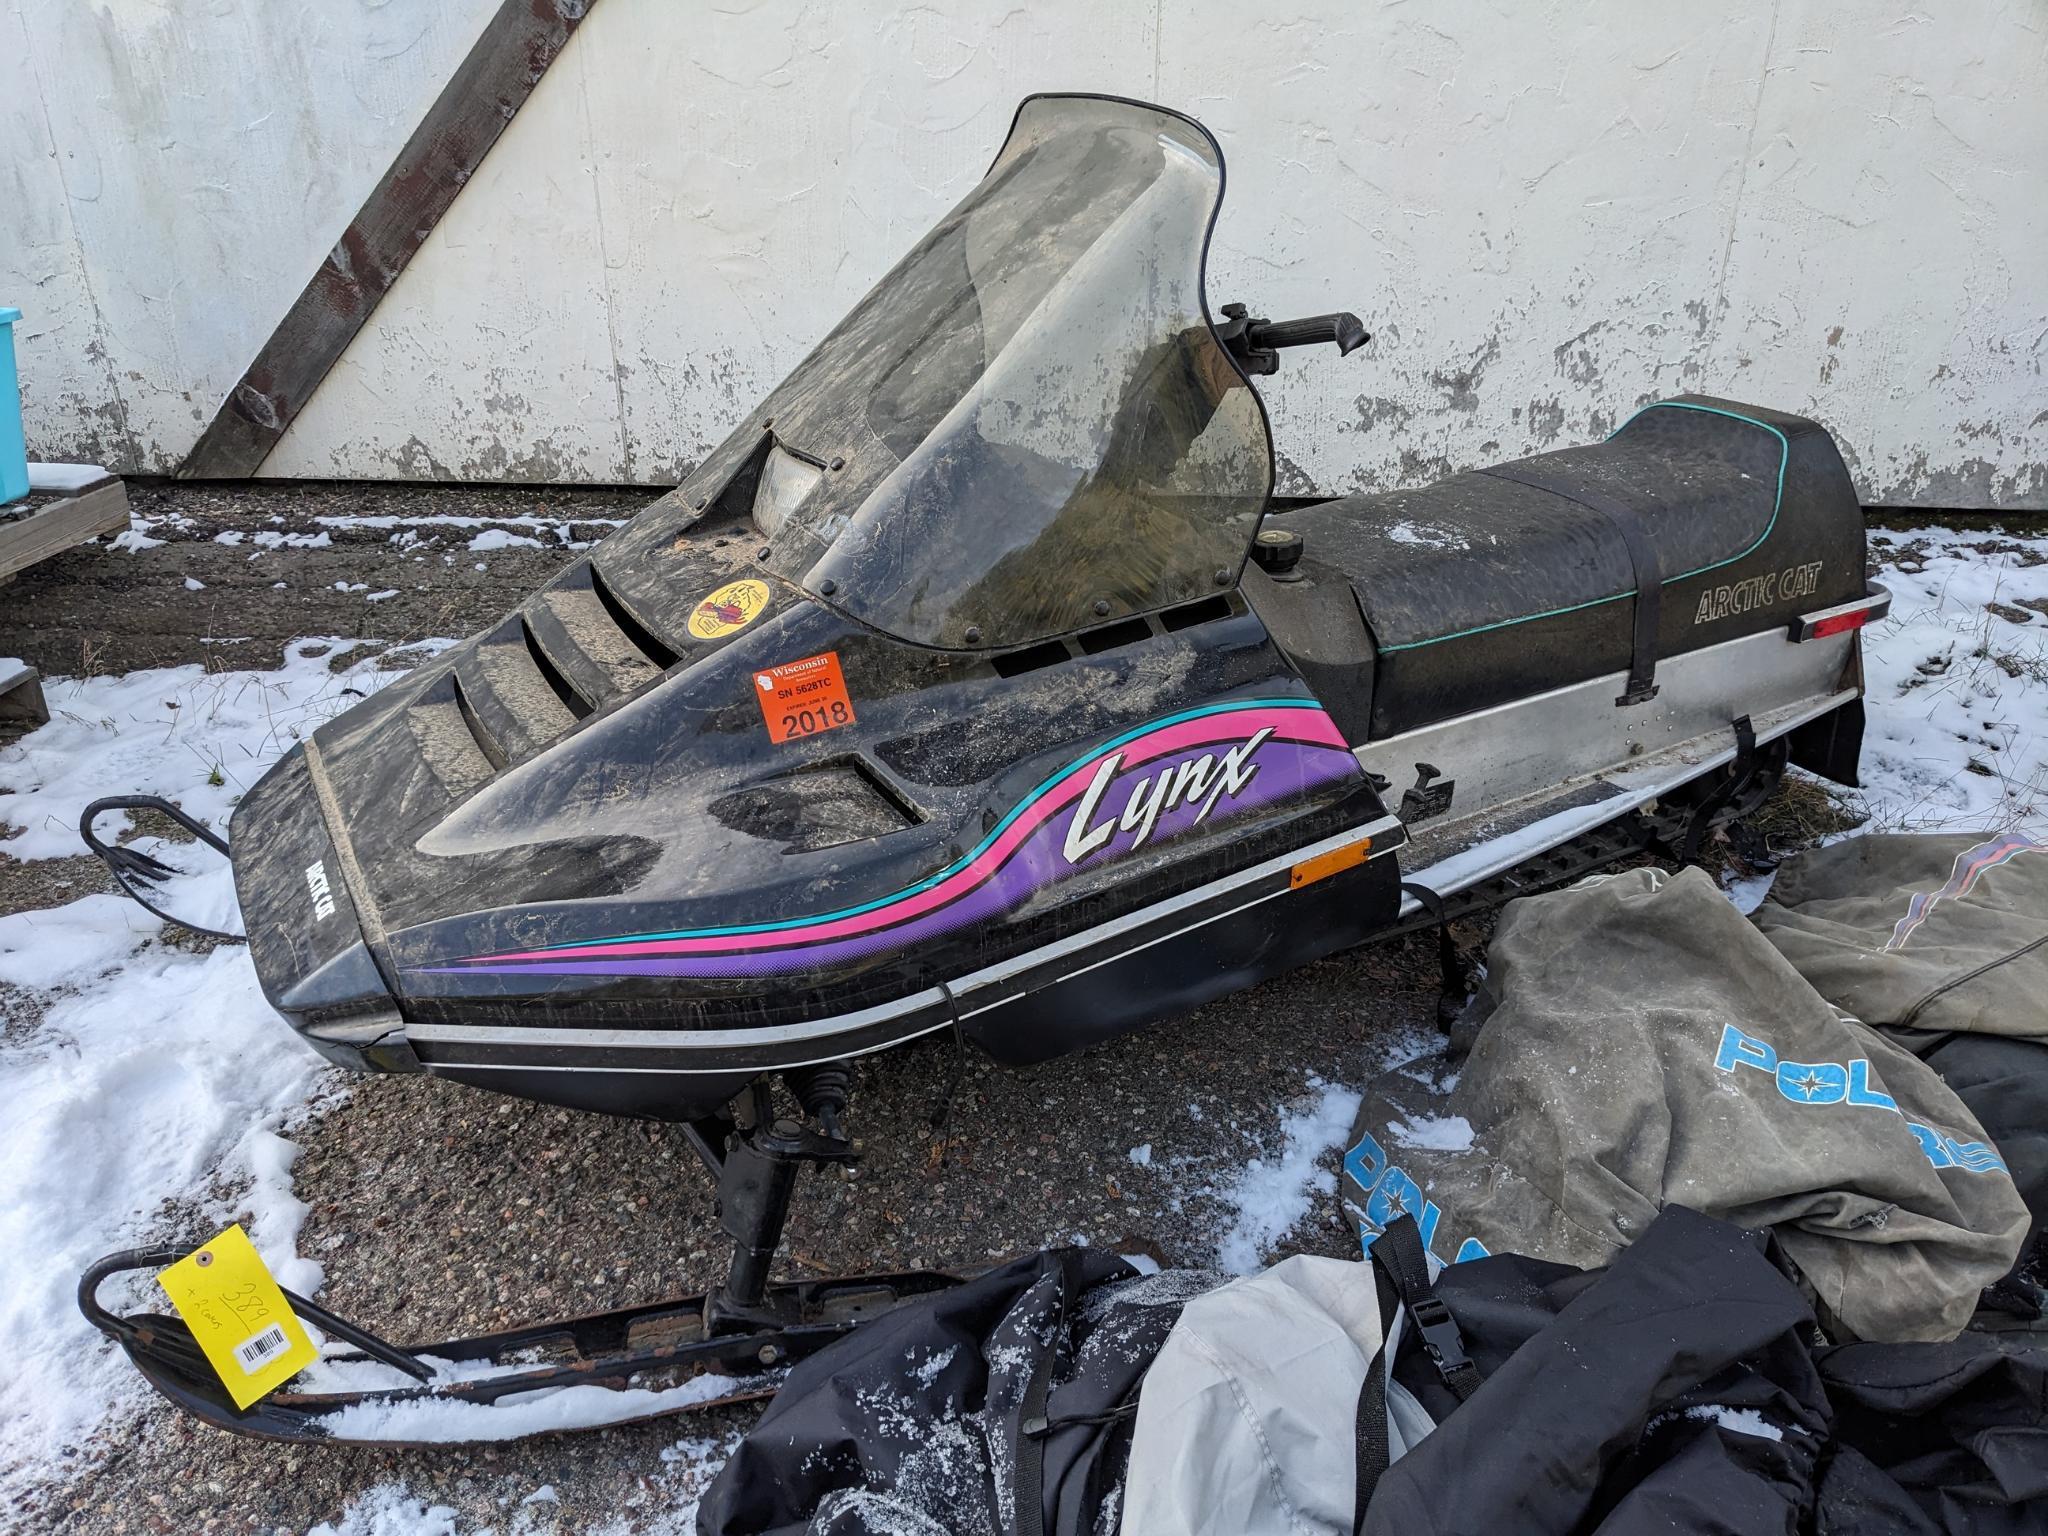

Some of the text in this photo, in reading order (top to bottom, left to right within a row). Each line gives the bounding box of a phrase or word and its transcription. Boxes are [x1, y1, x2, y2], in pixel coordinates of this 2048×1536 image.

[1694, 560, 1823, 625] ARCTIC CAT
[772, 656, 829, 678] Wisconsin
[777, 688, 793, 700] SN
[796, 677, 832, 695] 5628TC
[782, 700, 849, 739] 2018
[1062, 726, 1277, 865] Lynx
[222, 1282, 270, 1322] 389
